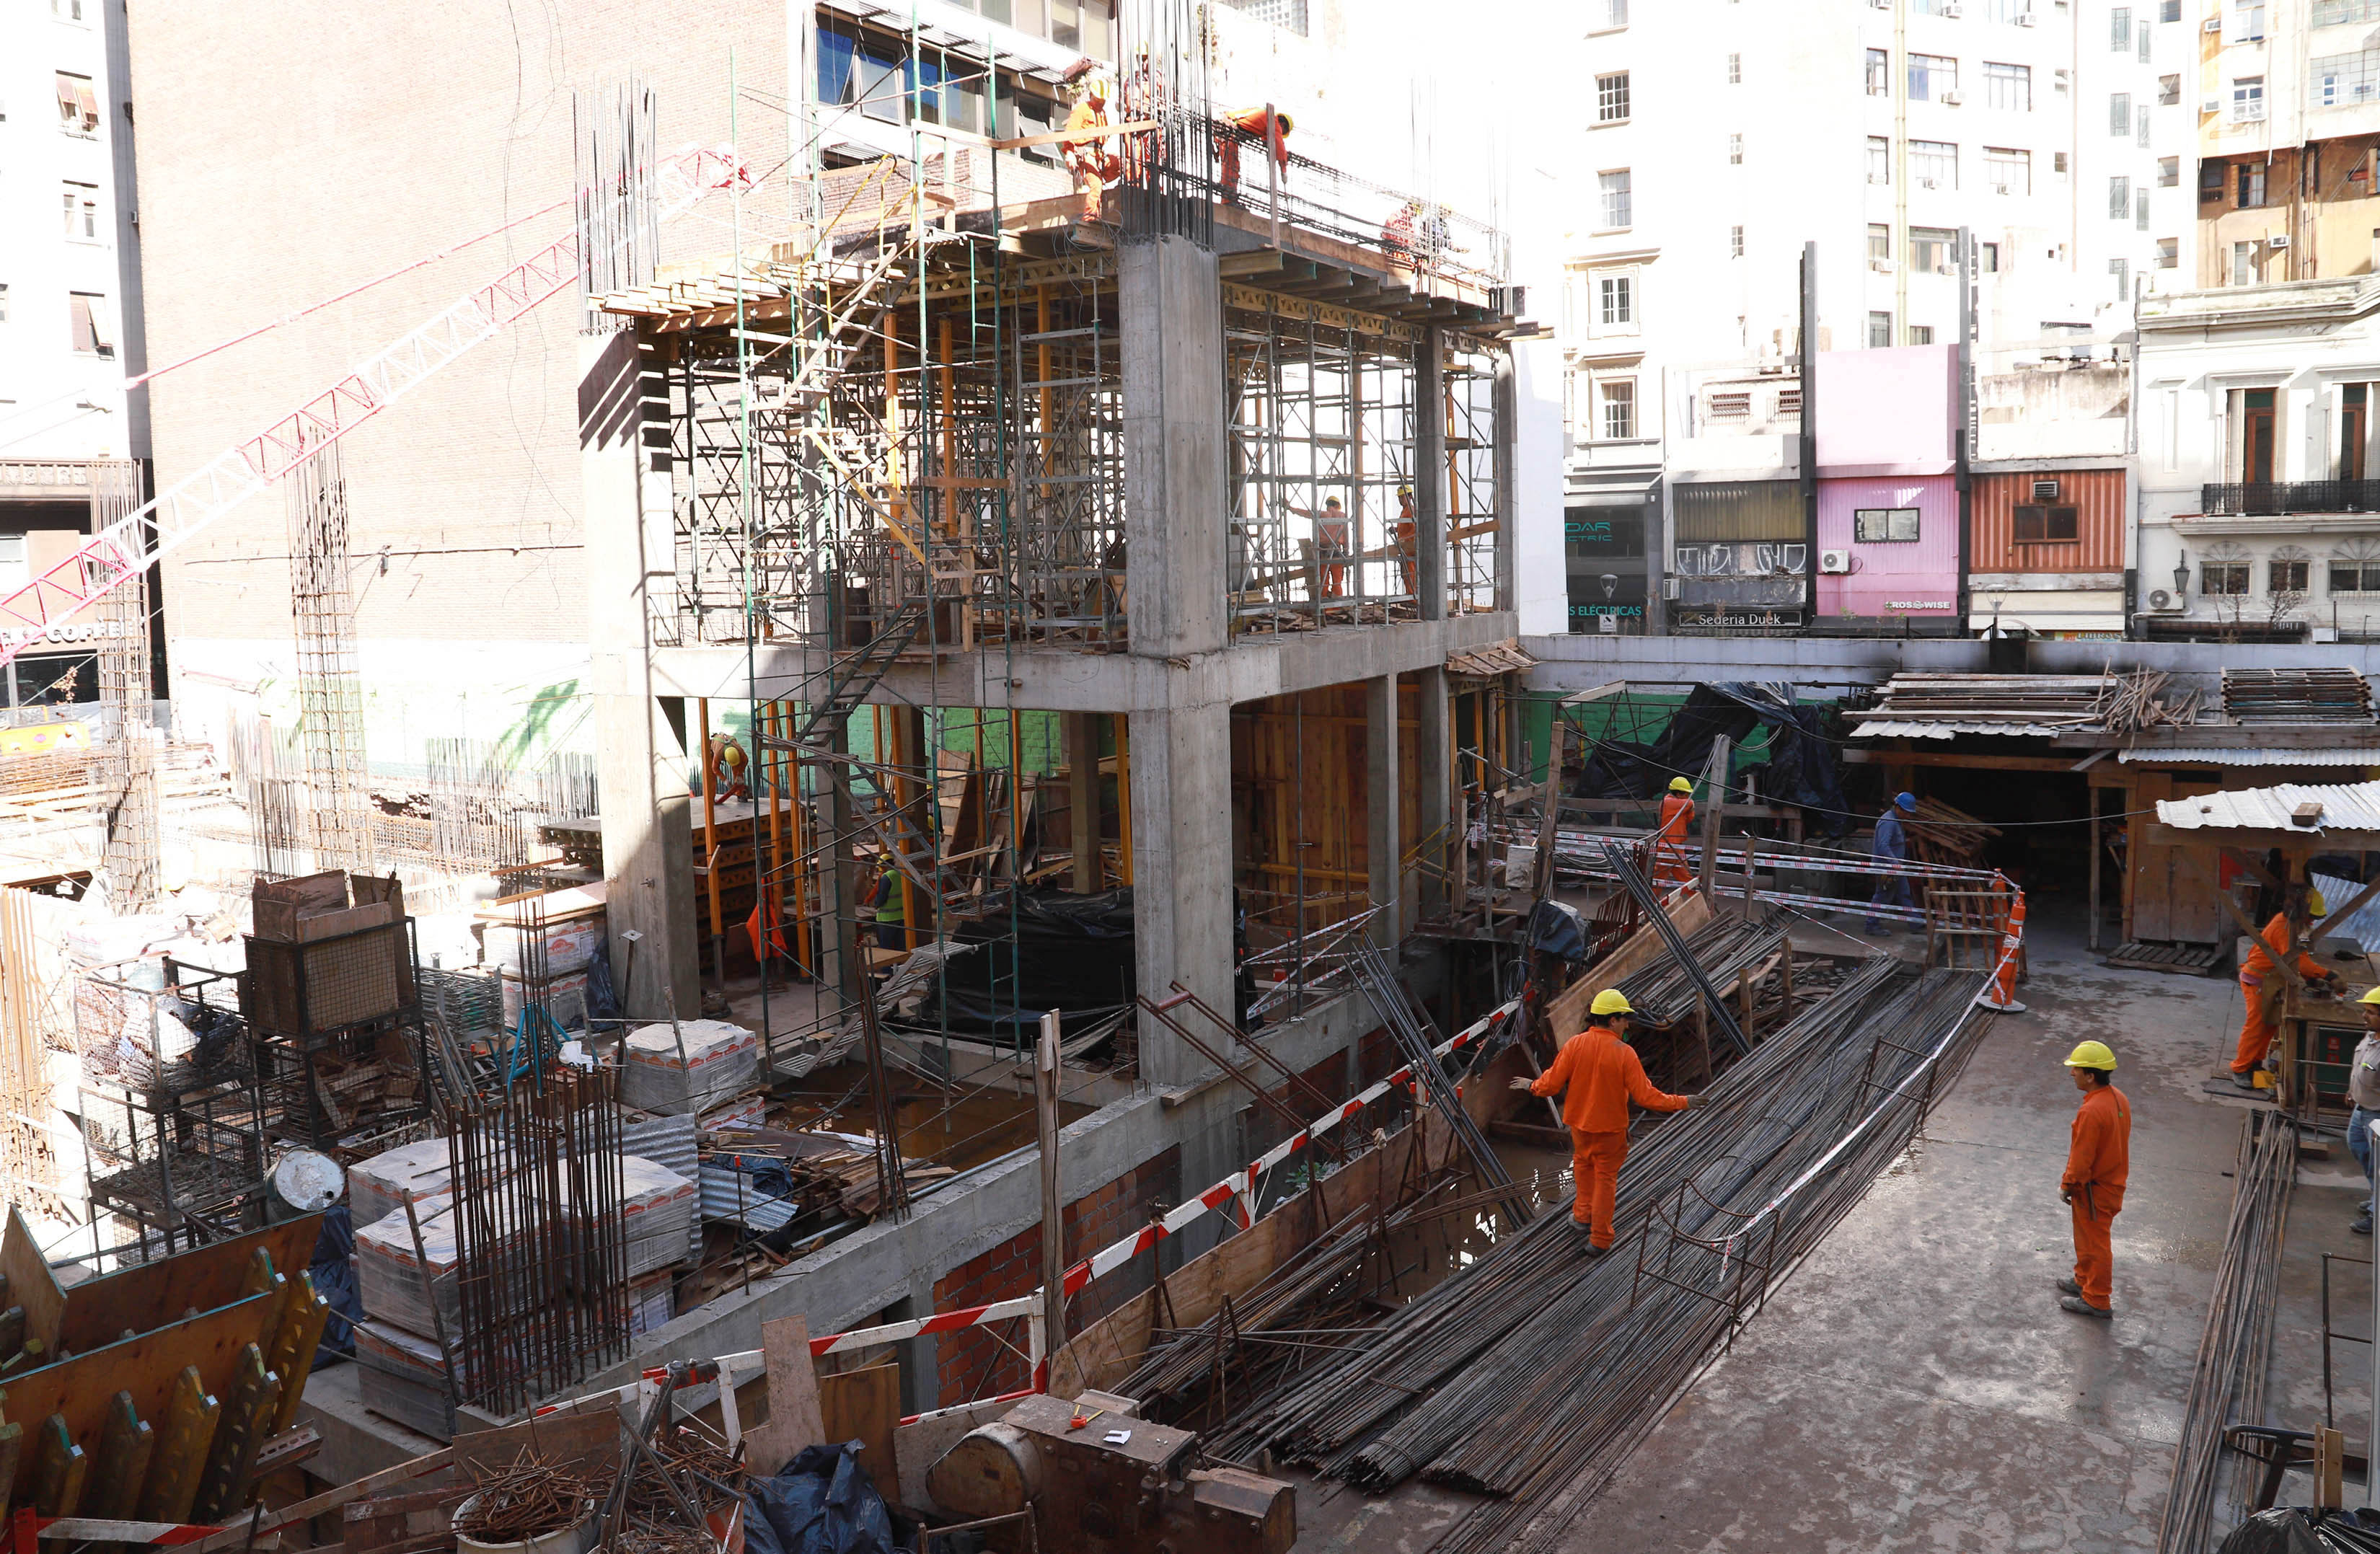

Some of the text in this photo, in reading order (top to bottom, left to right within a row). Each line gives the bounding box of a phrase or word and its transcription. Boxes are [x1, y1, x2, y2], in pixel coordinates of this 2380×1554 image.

[1565, 521, 1610, 532] DAR
[1569, 604, 1641, 617] S ELÉCTRICAS
[1698, 614, 1745, 624] Sederia
